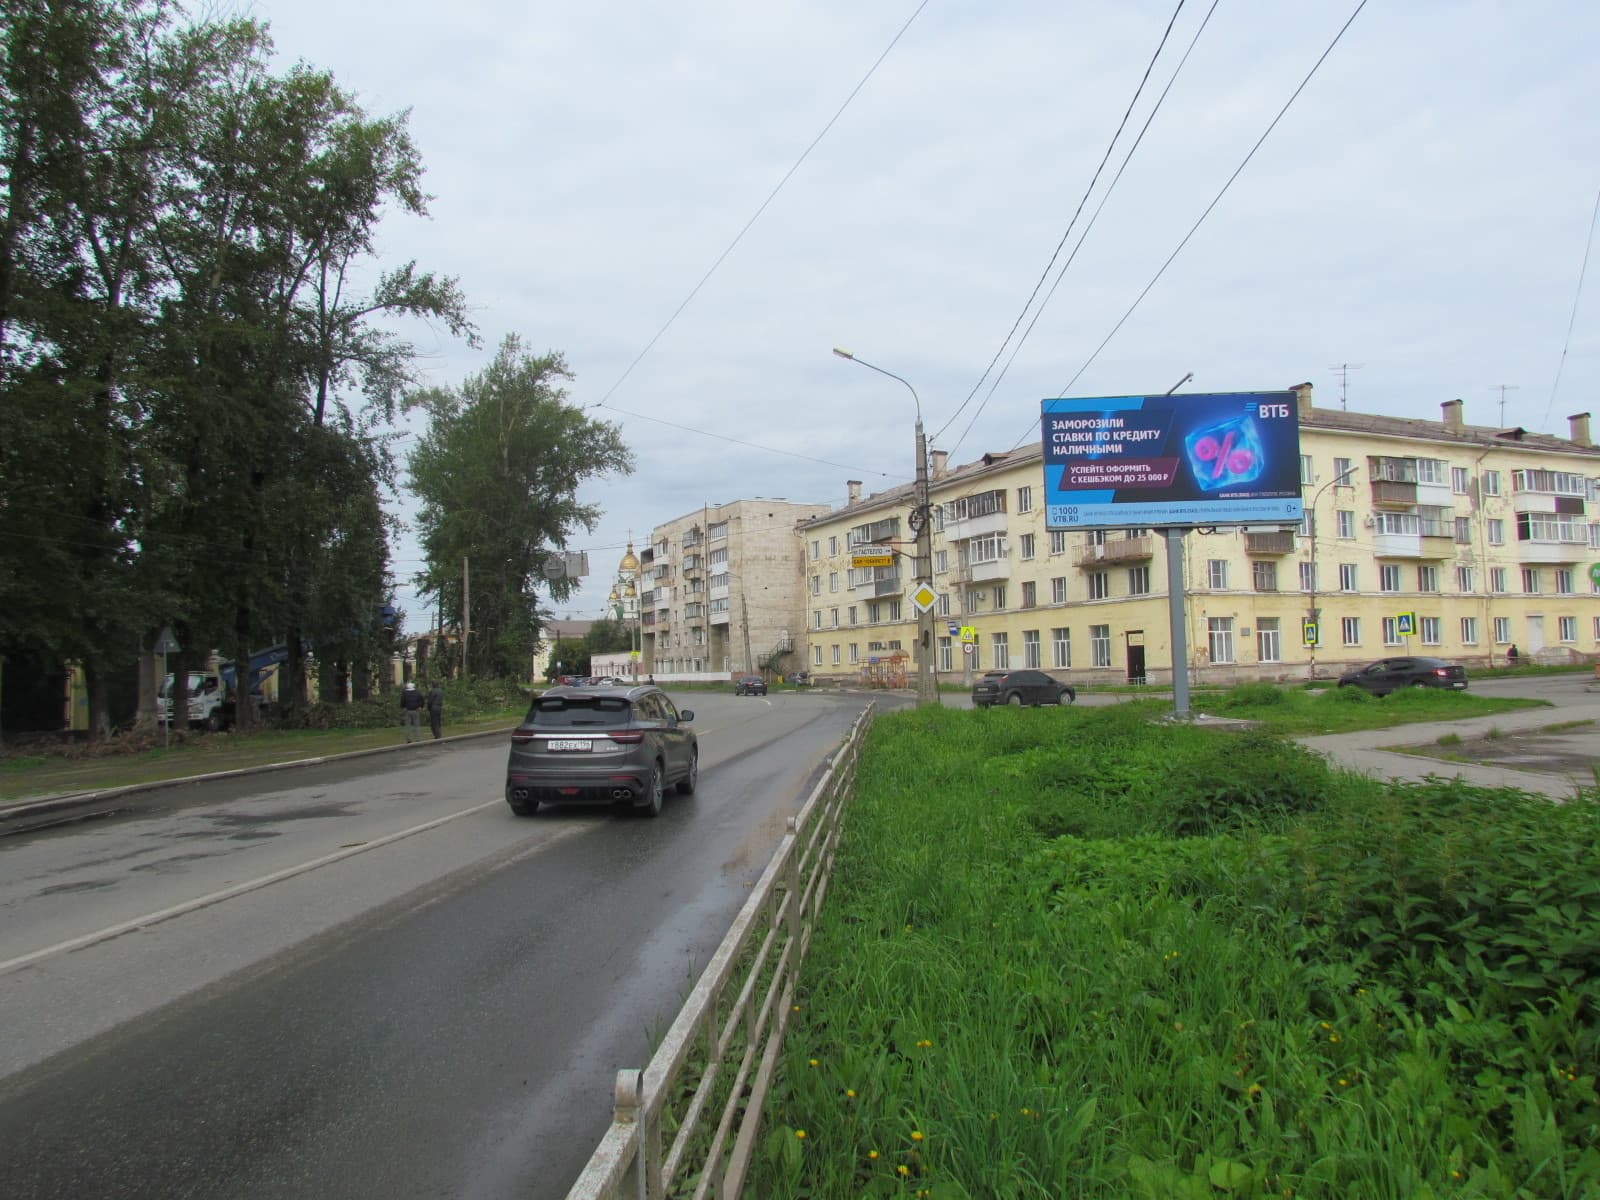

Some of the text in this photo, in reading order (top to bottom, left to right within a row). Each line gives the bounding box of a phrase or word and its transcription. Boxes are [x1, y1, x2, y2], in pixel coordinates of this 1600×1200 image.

[1259, 404, 1289, 418] ВТБ
[1051, 418, 1124, 430] ЗАМОРОЗИЛИ
[1052, 430, 1161, 443] СТАВКИ ПО КРЕДИТУ
[1053, 444, 1123, 456] НАЛИЧНЫМИ
[1070, 464, 1151, 474] УСПЕЙТЕ ОФОРМИТЬ
[1071, 476, 1077, 484] С
[1078, 475, 1122, 484] КЕШБЭКОМ
[1123, 475, 1135, 484] ДО
[1137, 474, 1146, 482] 25
[1059, 506, 1079, 515] 1000
[1286, 504, 1297, 513] 0+
[1053, 515, 1079, 523] VTB.RU
